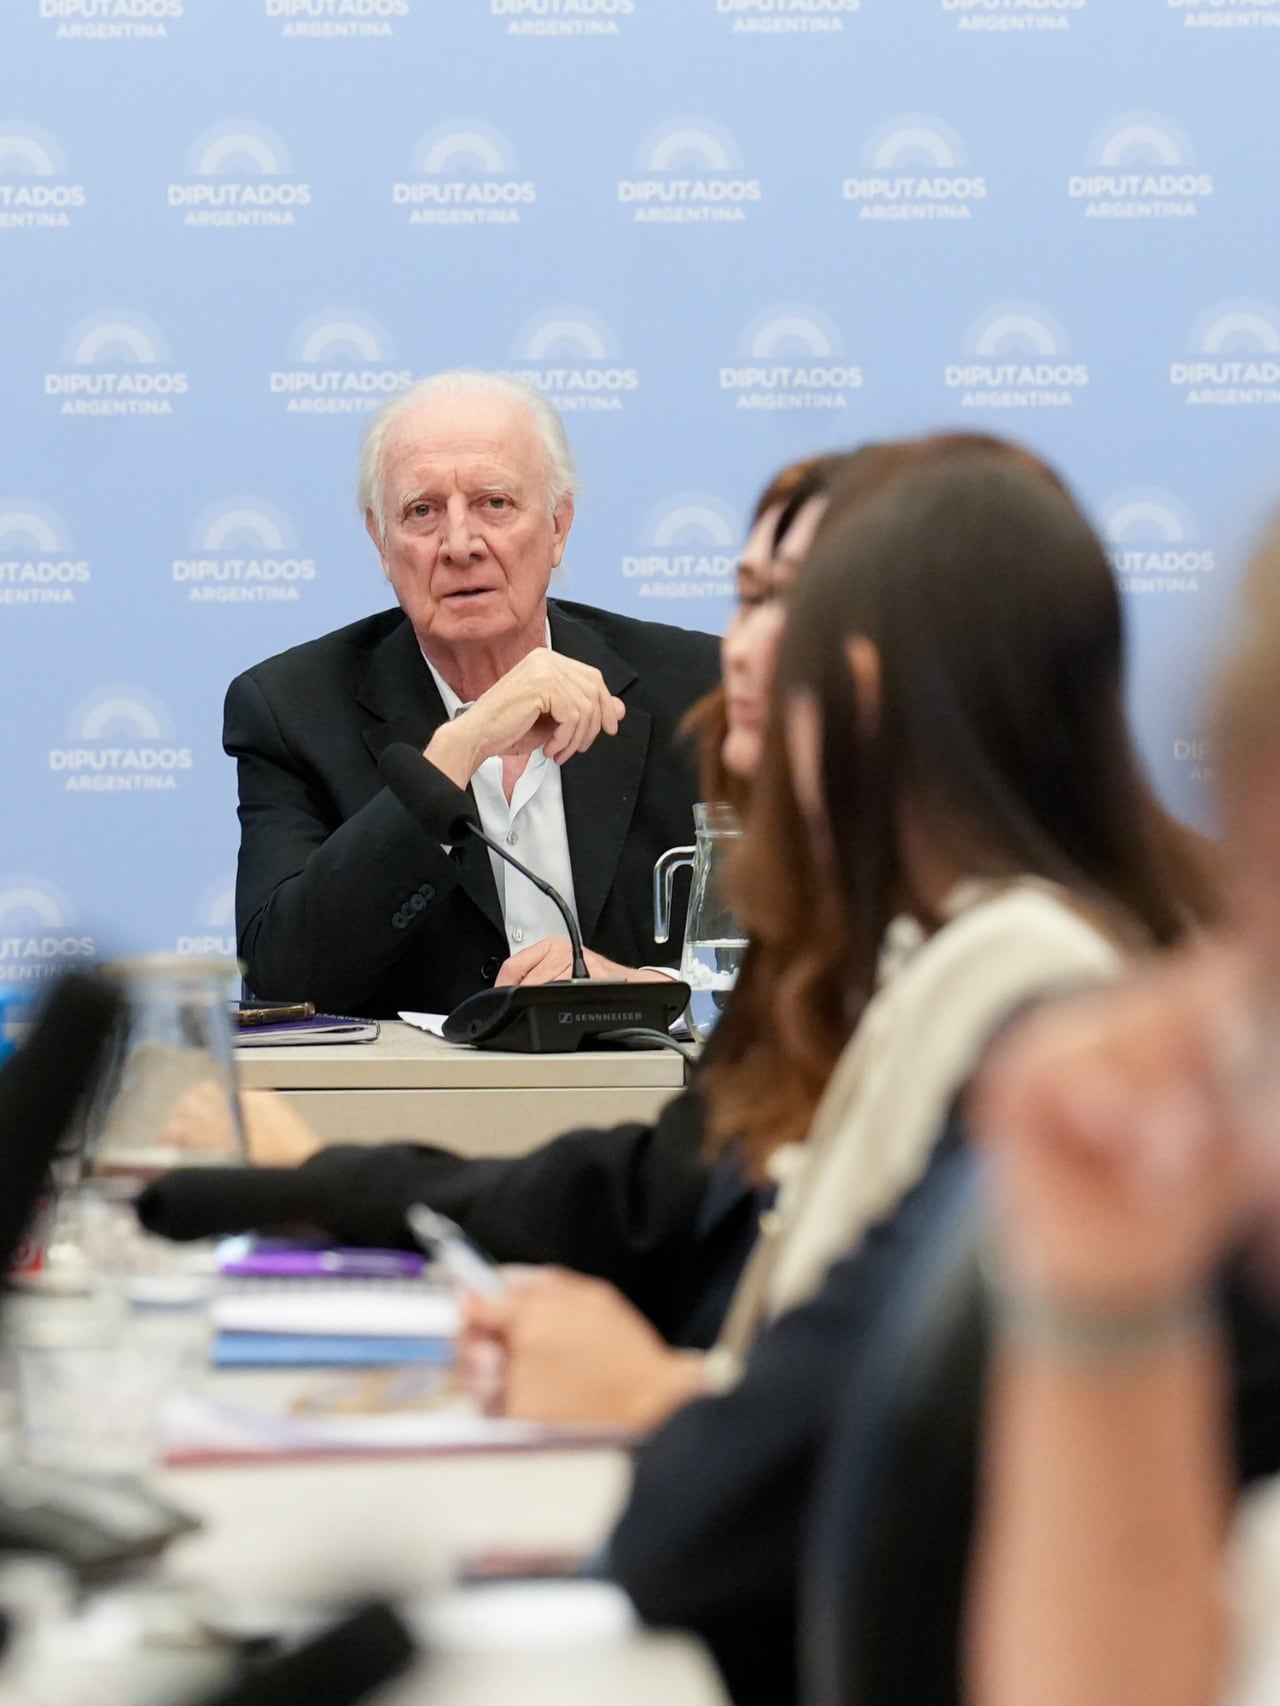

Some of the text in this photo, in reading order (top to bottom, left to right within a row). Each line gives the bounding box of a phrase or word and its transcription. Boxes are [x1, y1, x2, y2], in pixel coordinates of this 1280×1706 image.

[39, 0, 184, 16] DIPUTADOS
[265, 0, 410, 15] DIPUTADOS
[507, 20, 619, 35] ARGENTINA
[732, 17, 844, 33] ARGENTINA
[957, 15, 1070, 30] ARGENTINA
[1183, 11, 1280, 28] ARGENTIN
[56, 24, 168, 38] ARGENTINA
[282, 22, 393, 37] ARGENTINA
[392, 183, 537, 202] DIPUTADOS
[617, 181, 762, 200] DIPUTADOS
[842, 178, 987, 198] DIPUTADOS
[1068, 176, 1214, 195] DIPUTADOS
[167, 185, 312, 204] DIPUTADOS
[409, 209, 520, 224] ARGENTINA
[633, 207, 746, 222] ARGENTINA
[858, 204, 971, 219] ARGENTINA
[1085, 202, 1197, 218] ARGENTINA
[184, 211, 295, 226] ARGENTINA
[719, 368, 864, 389] DIPUTADOS
[944, 366, 1089, 387] DIPUTADOS
[1169, 363, 1280, 385] DIPUTAD
[43, 374, 189, 393] DIPUTADOS
[552, 395, 623, 411] ENTINA
[736, 393, 848, 409] ARGENTINA
[961, 392, 1073, 408] ARGENTINA
[1186, 389, 1280, 405] ARGENTIN
[60, 400, 173, 415] ARGENTINA
[621, 556, 737, 577] DIPUTAD
[1113, 551, 1216, 572] UTADOS
[171, 560, 317, 580] DIPUTADOS
[188, 586, 300, 602] ARGENTINA
[638, 582, 737, 598] ARGENTIN
[48, 749, 194, 769] DIPUTADOS
[65, 775, 177, 791] ARGENTINA
